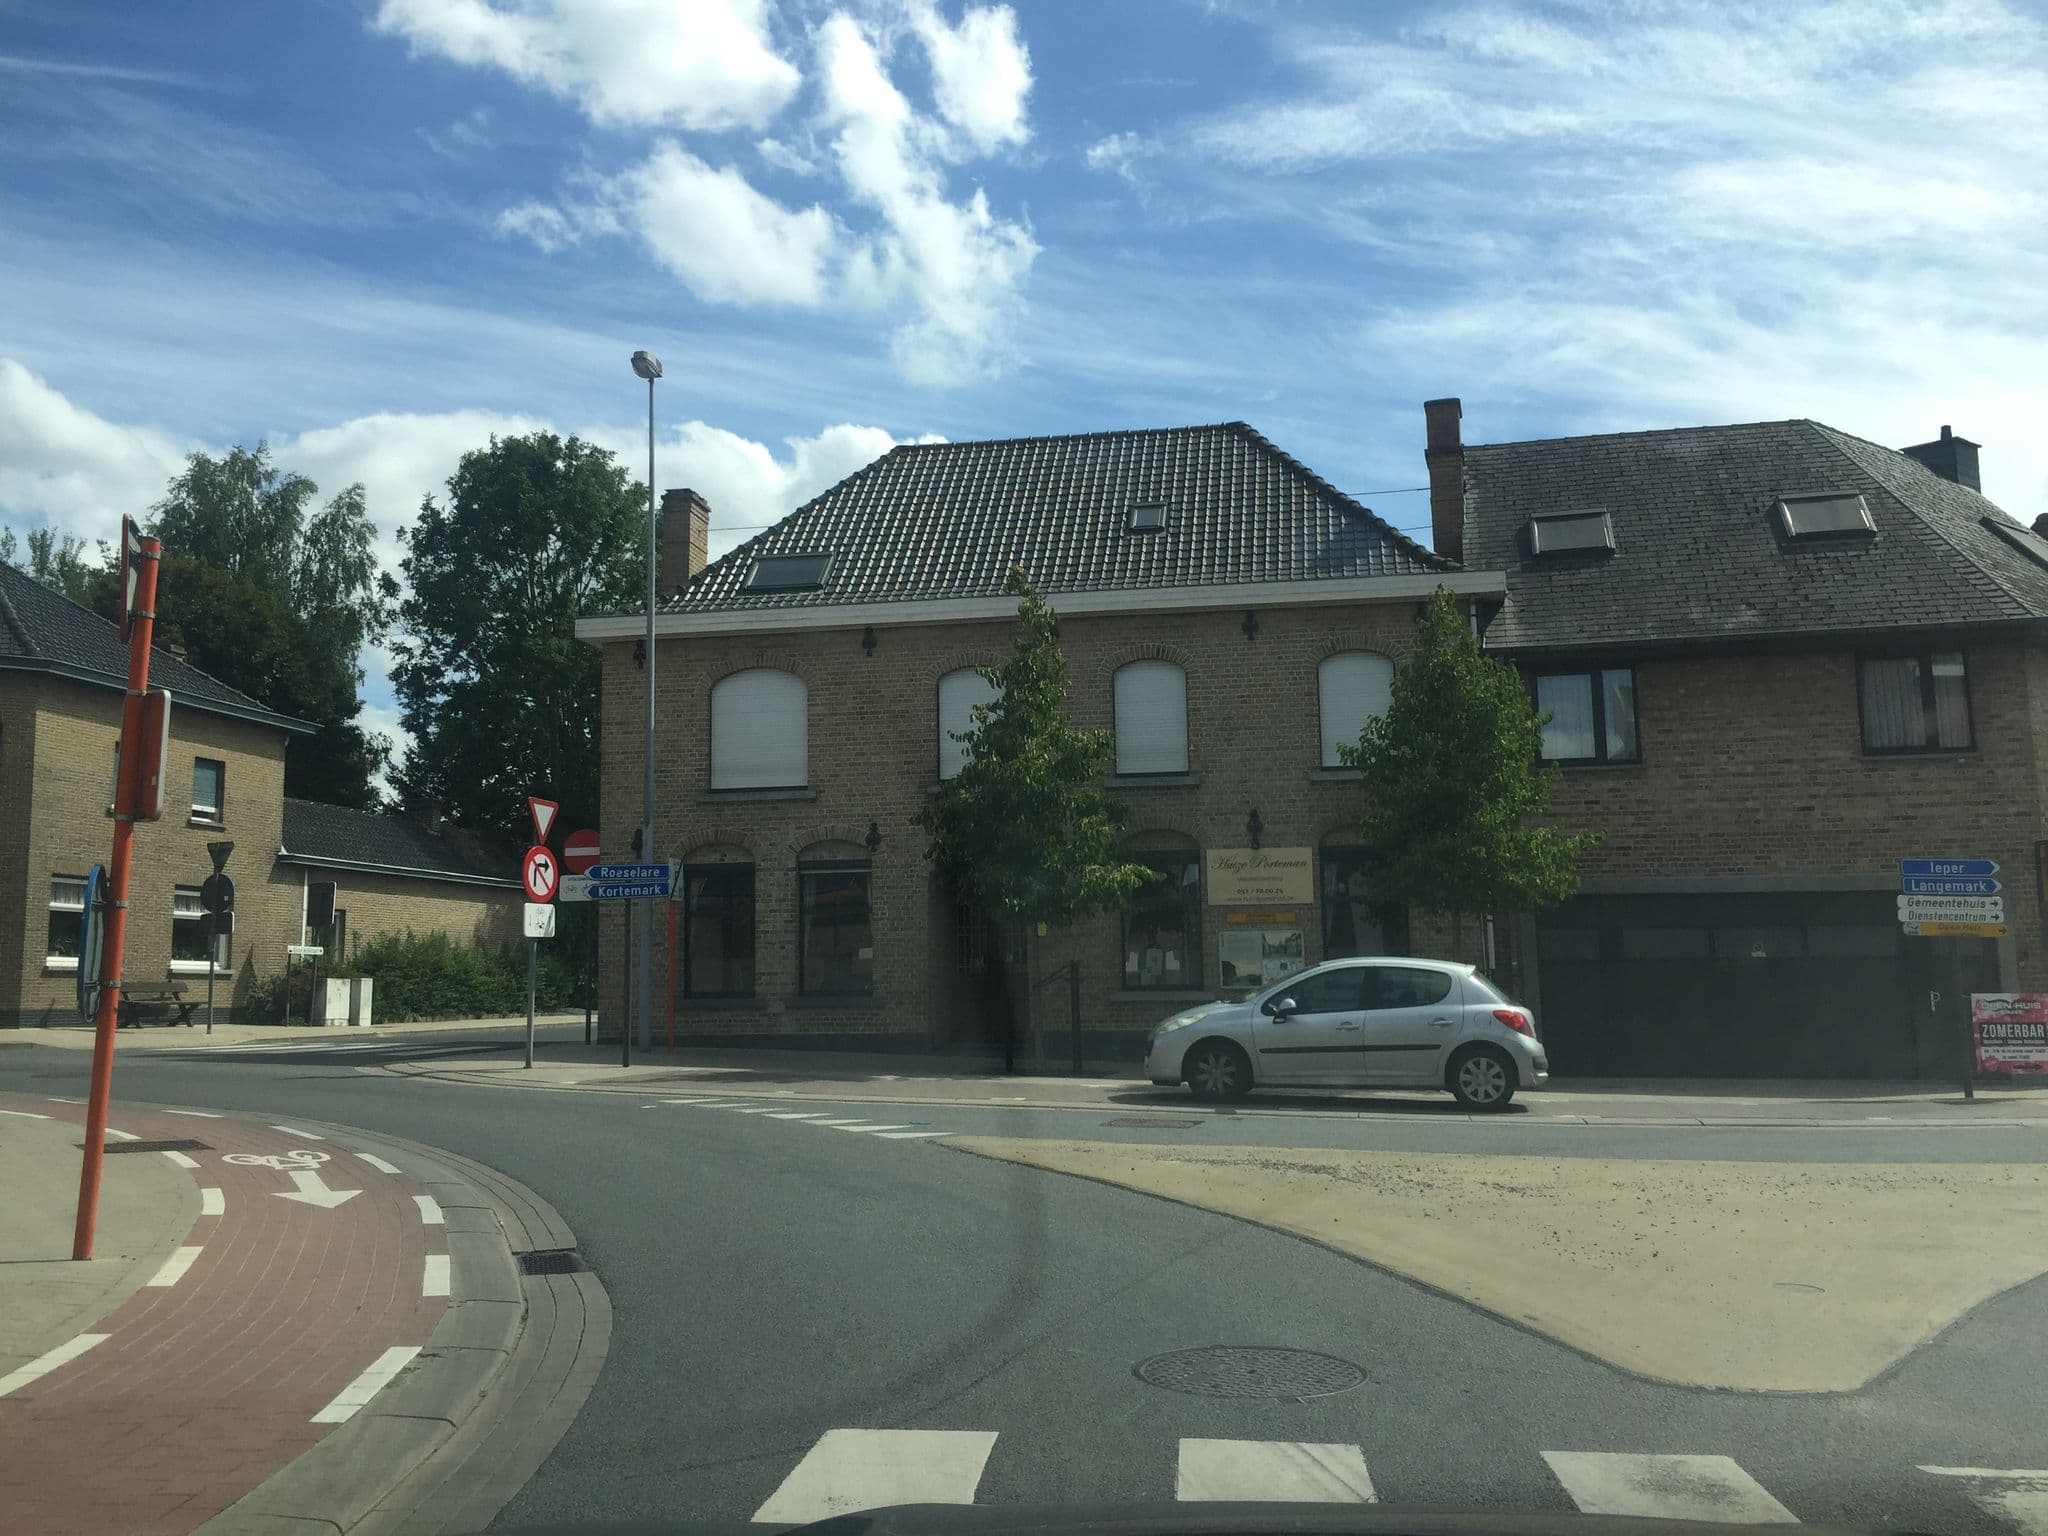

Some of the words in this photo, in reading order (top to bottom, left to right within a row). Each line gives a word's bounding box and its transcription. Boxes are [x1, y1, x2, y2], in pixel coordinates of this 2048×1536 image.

[601, 867, 661, 878] Roeselare
[1930, 862, 1964, 875] Ieper
[599, 884, 662, 897] Kortemark
[1911, 880, 1988, 894] Langemark
[1907, 898, 1986, 908] Gemeentehuis
[1908, 911, 1987, 921] Dienstencentrum
[1982, 1024, 2045, 1038] ZOMERBAR
